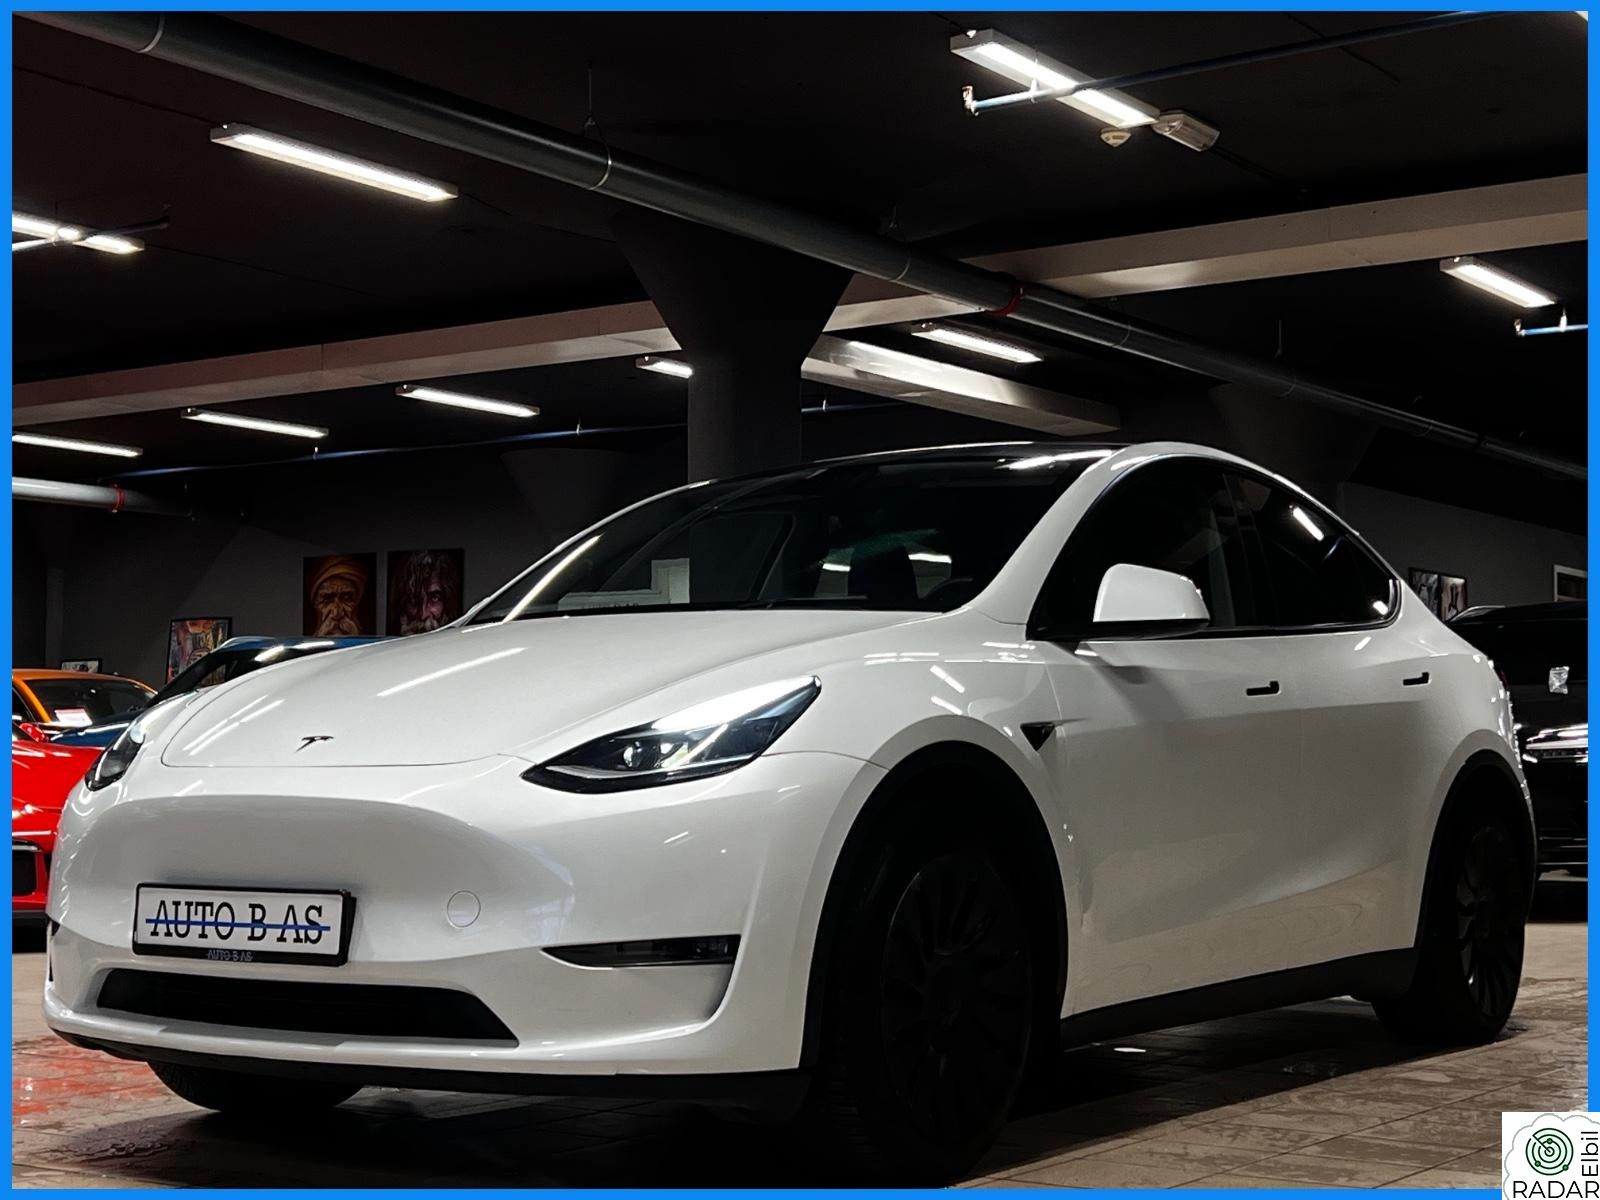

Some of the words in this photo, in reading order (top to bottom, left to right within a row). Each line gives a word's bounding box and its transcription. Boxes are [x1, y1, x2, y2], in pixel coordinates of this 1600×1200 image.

[150, 900, 235, 940] AUTO
[247, 903, 267, 941] B
[276, 904, 323, 944] AS
[207, 948, 230, 961] AUTO
